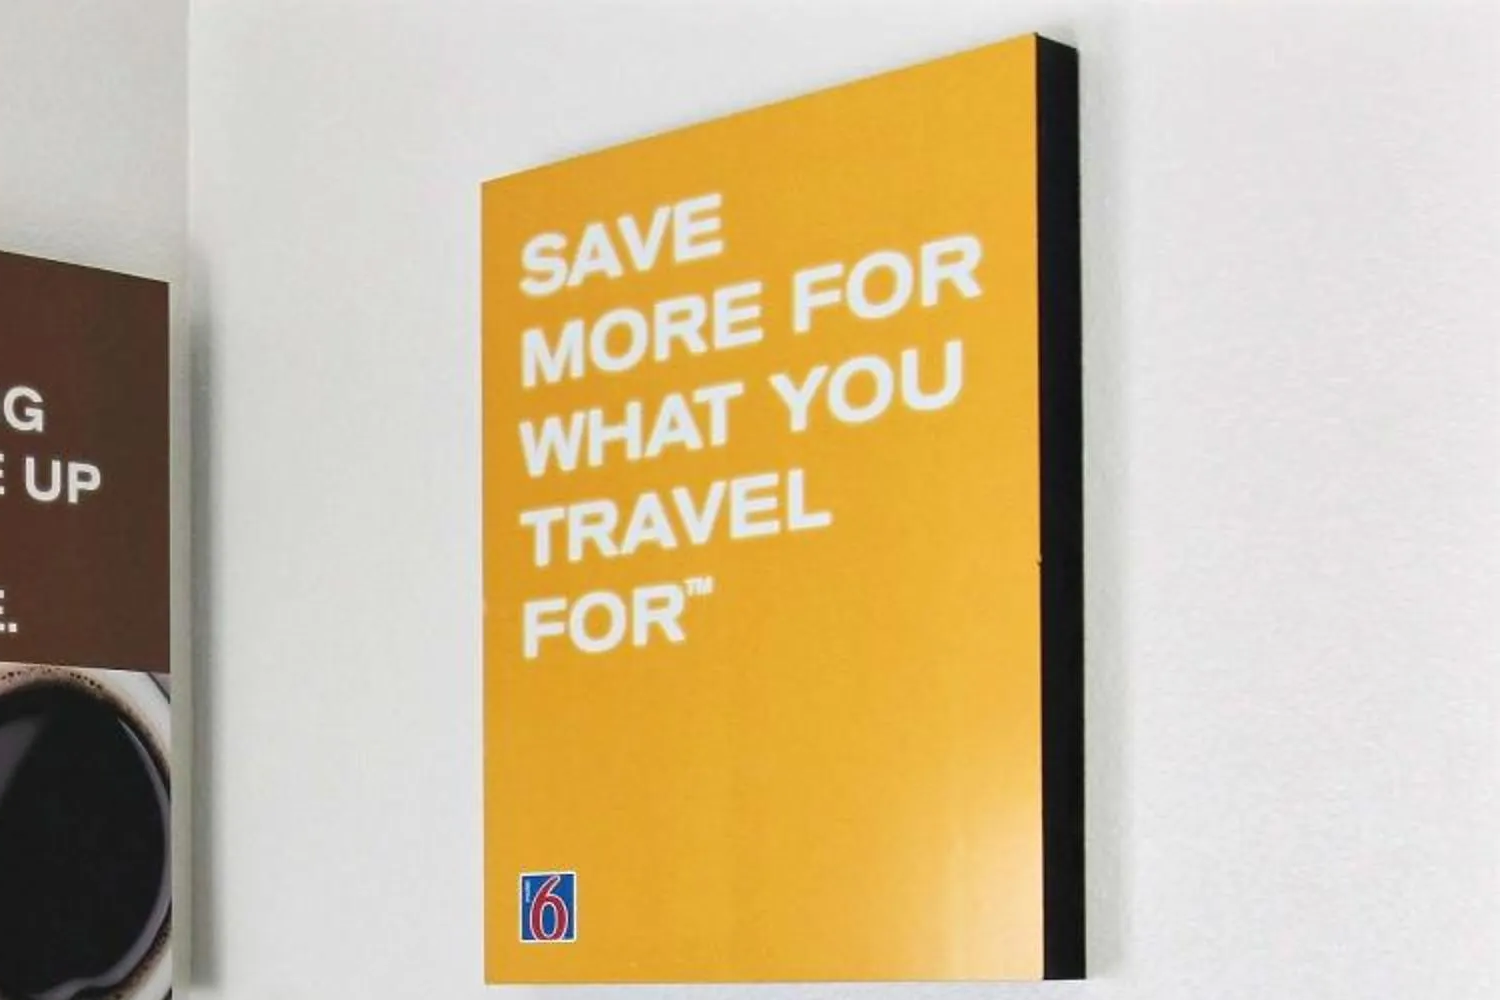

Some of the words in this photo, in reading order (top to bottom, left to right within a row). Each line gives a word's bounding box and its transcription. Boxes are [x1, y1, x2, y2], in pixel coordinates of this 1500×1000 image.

[520, 192, 724, 297] SAVE
[521, 280, 764, 388] MORE
[792, 234, 984, 334] FOR
[518, 381, 745, 478] WHAT
[769, 339, 964, 433] YOU
[25, 456, 102, 504] UP
[519, 468, 834, 568] TRAVEL
[529, 875, 569, 941] 6
